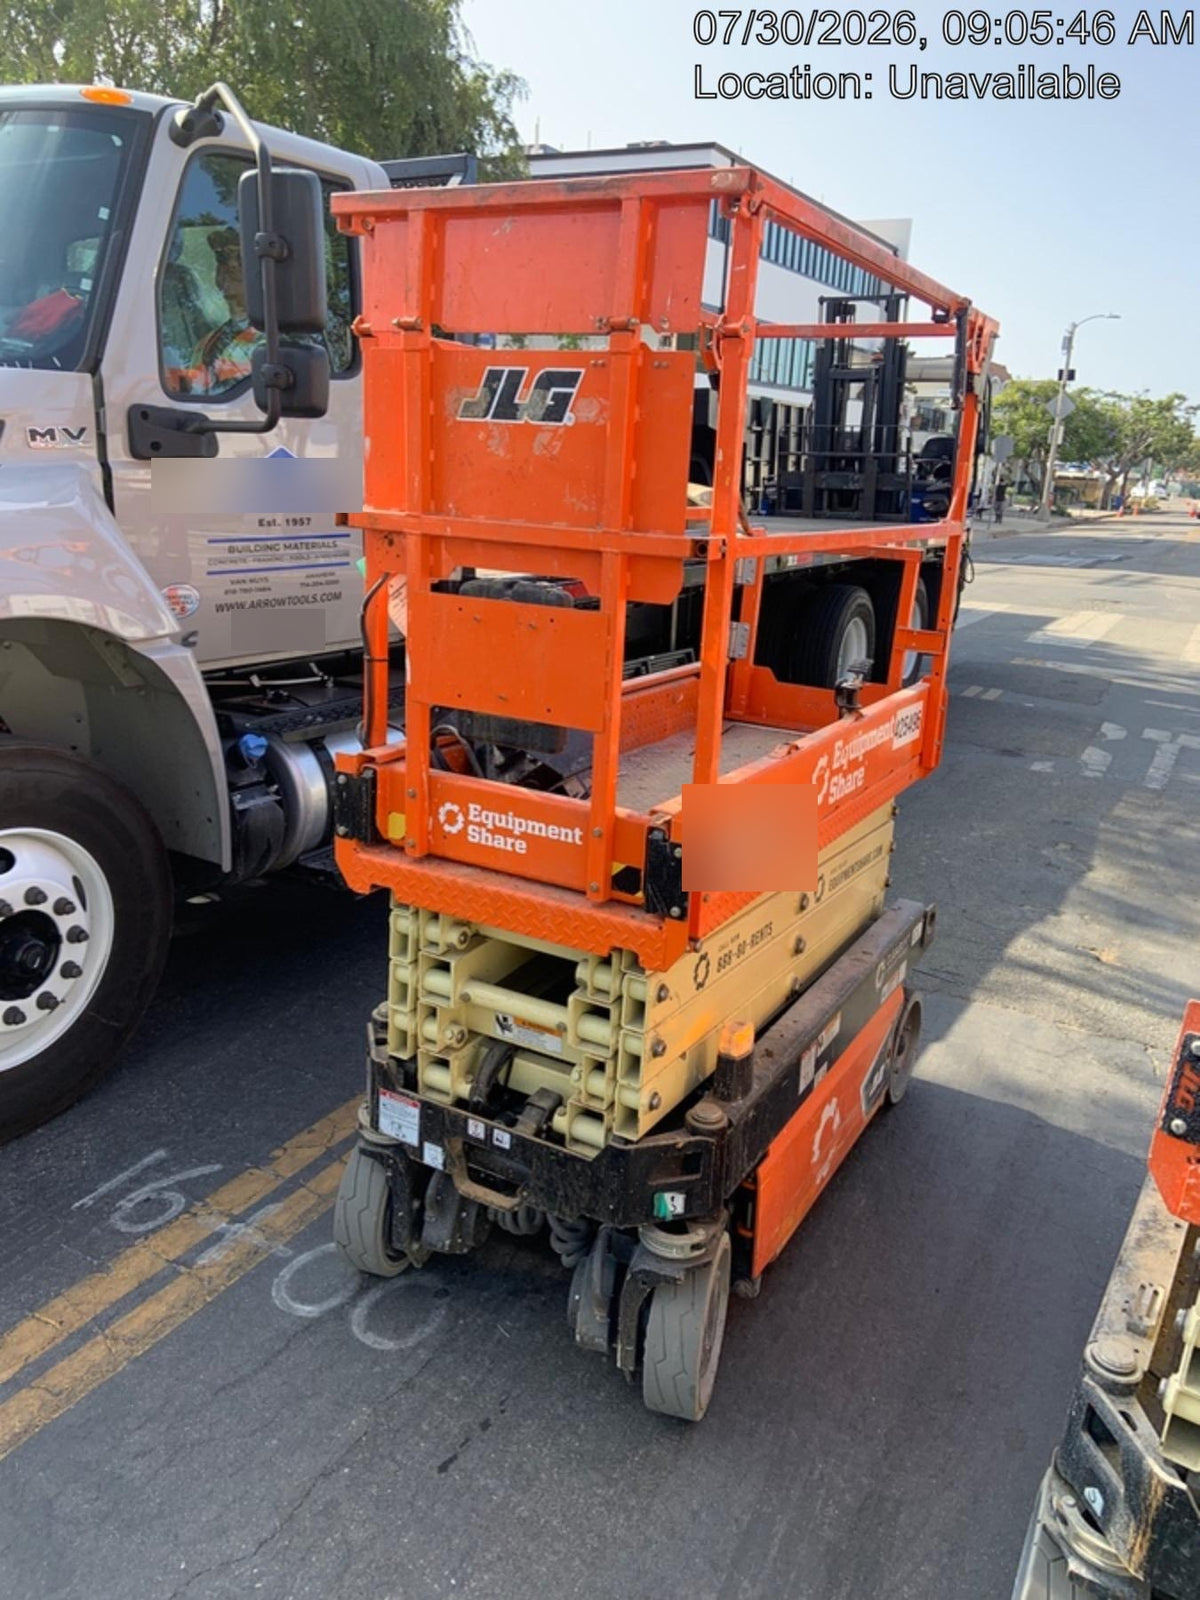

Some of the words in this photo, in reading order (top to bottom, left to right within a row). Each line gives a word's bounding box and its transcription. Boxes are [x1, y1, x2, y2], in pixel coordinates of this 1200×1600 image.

[456, 366, 585, 425] JLG
[27, 426, 88, 443] MV
[257, 518, 281, 527] Est.
[285, 516, 312, 527] 1957
[227, 543, 281, 554] BUILDING
[283, 540, 338, 552] MATERIALS
[214, 591, 343, 613] WWW.ARROWTOOLS.COM
[832, 714, 896, 770] Equipment
[828, 766, 866, 805] Share
[467, 803, 584, 845] Equipment
[467, 826, 528, 854] Share
